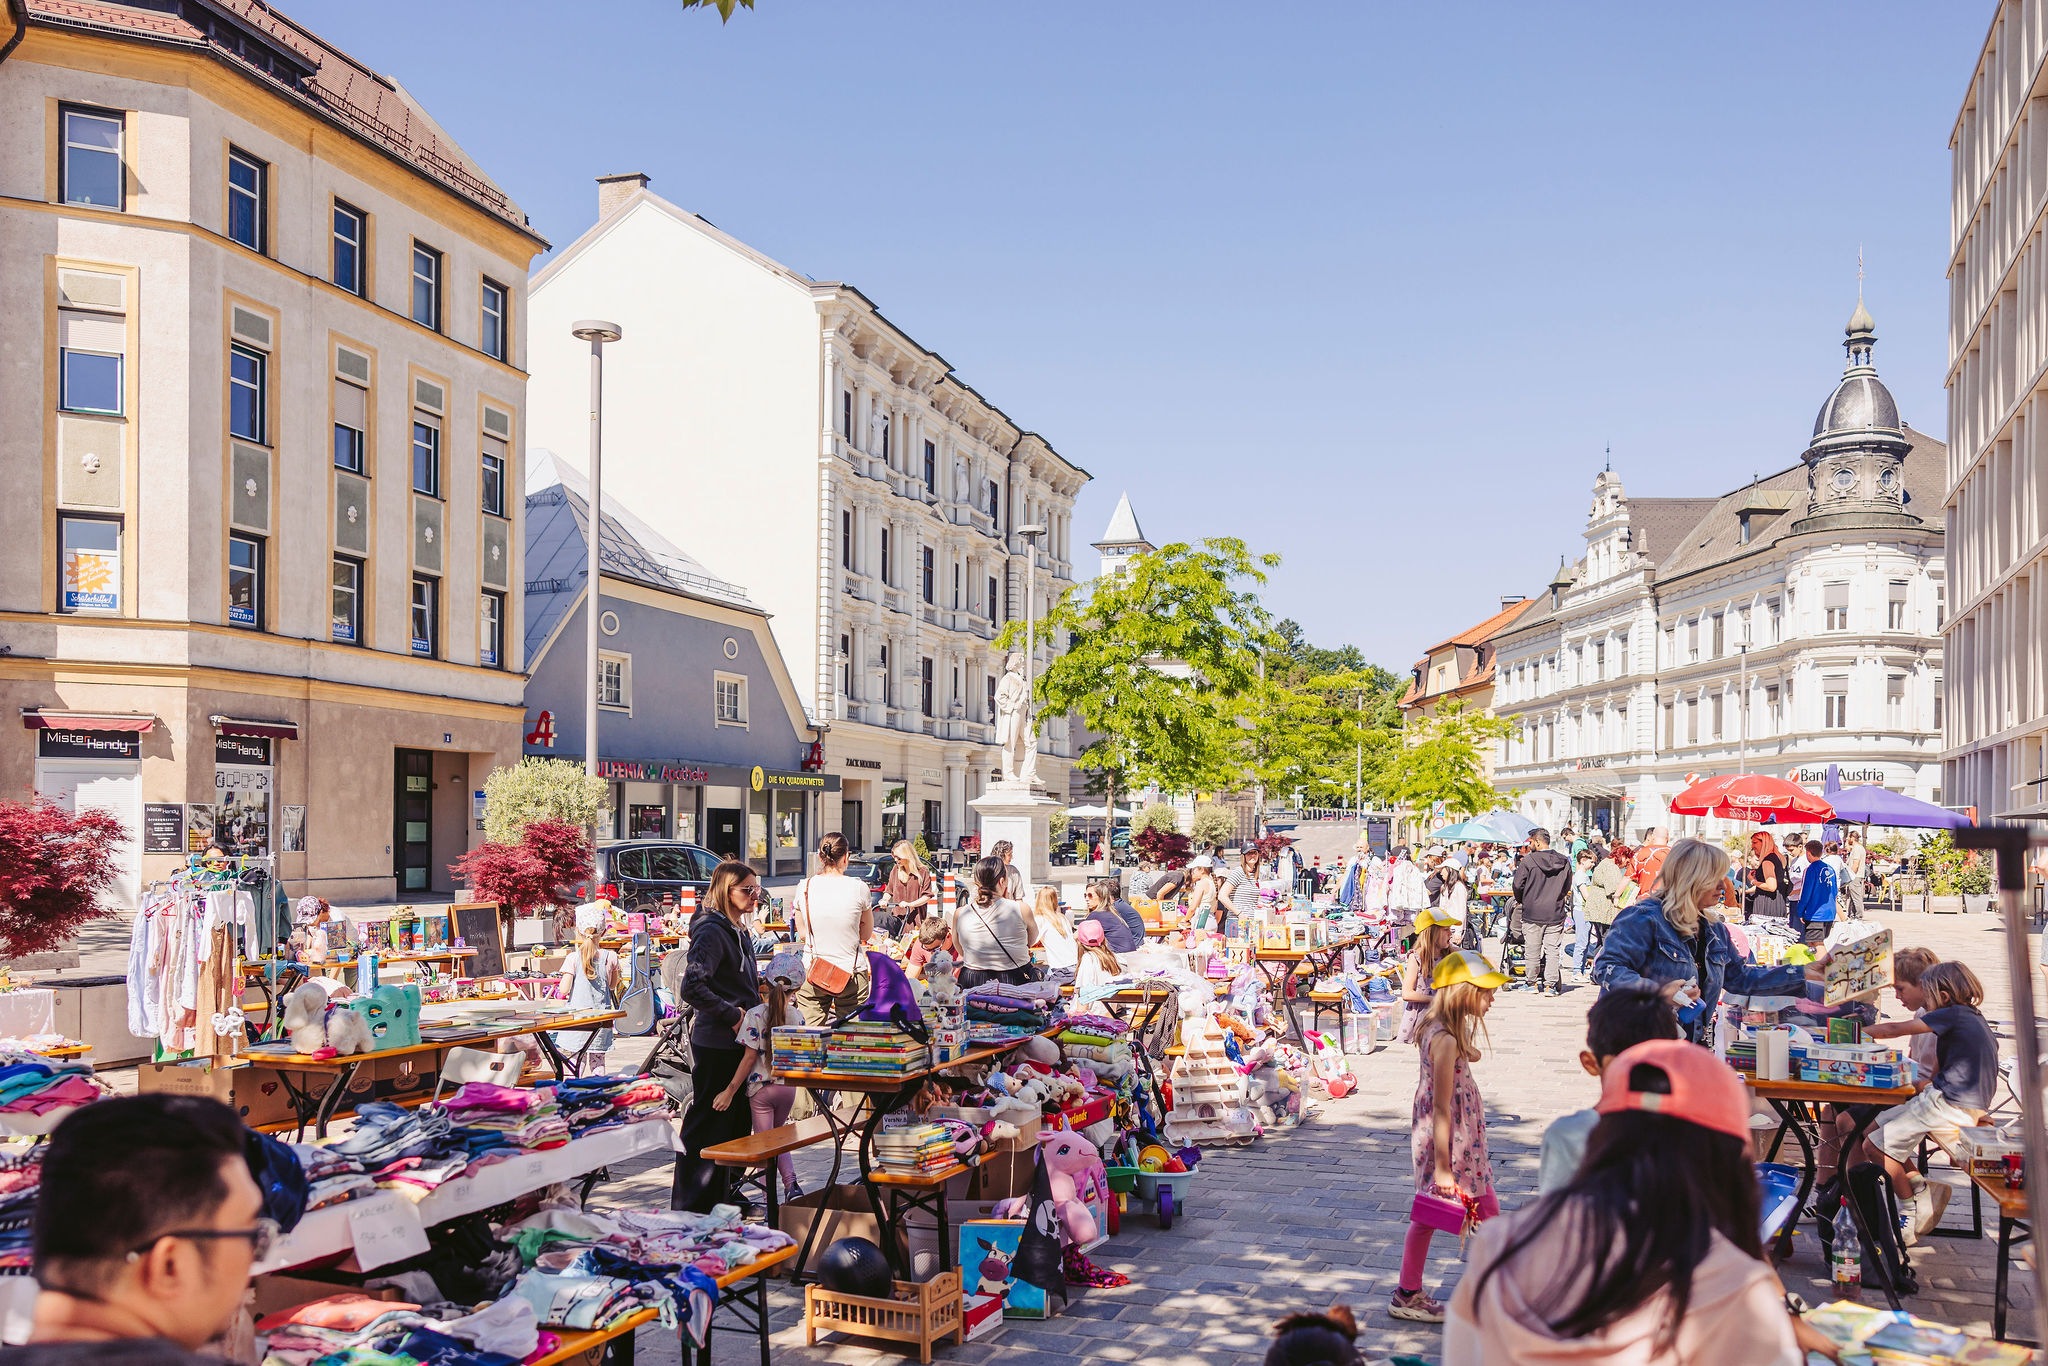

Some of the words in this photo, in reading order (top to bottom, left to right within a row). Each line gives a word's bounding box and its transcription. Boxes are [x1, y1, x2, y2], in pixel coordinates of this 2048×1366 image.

[47, 732, 91, 743] Mister
[87, 738, 128, 753] Handy
[238, 745, 264, 759] Handy
[597, 761, 644, 779] ULFENIA
[661, 764, 709, 782] Apotheke
[1838, 768, 1884, 782] Austria
[768, 775, 778, 784] DIE
[778, 776, 786, 784] 90
[786, 776, 825, 787] QUADRATMETER
[1737, 795, 1774, 805] Coca-Cola
